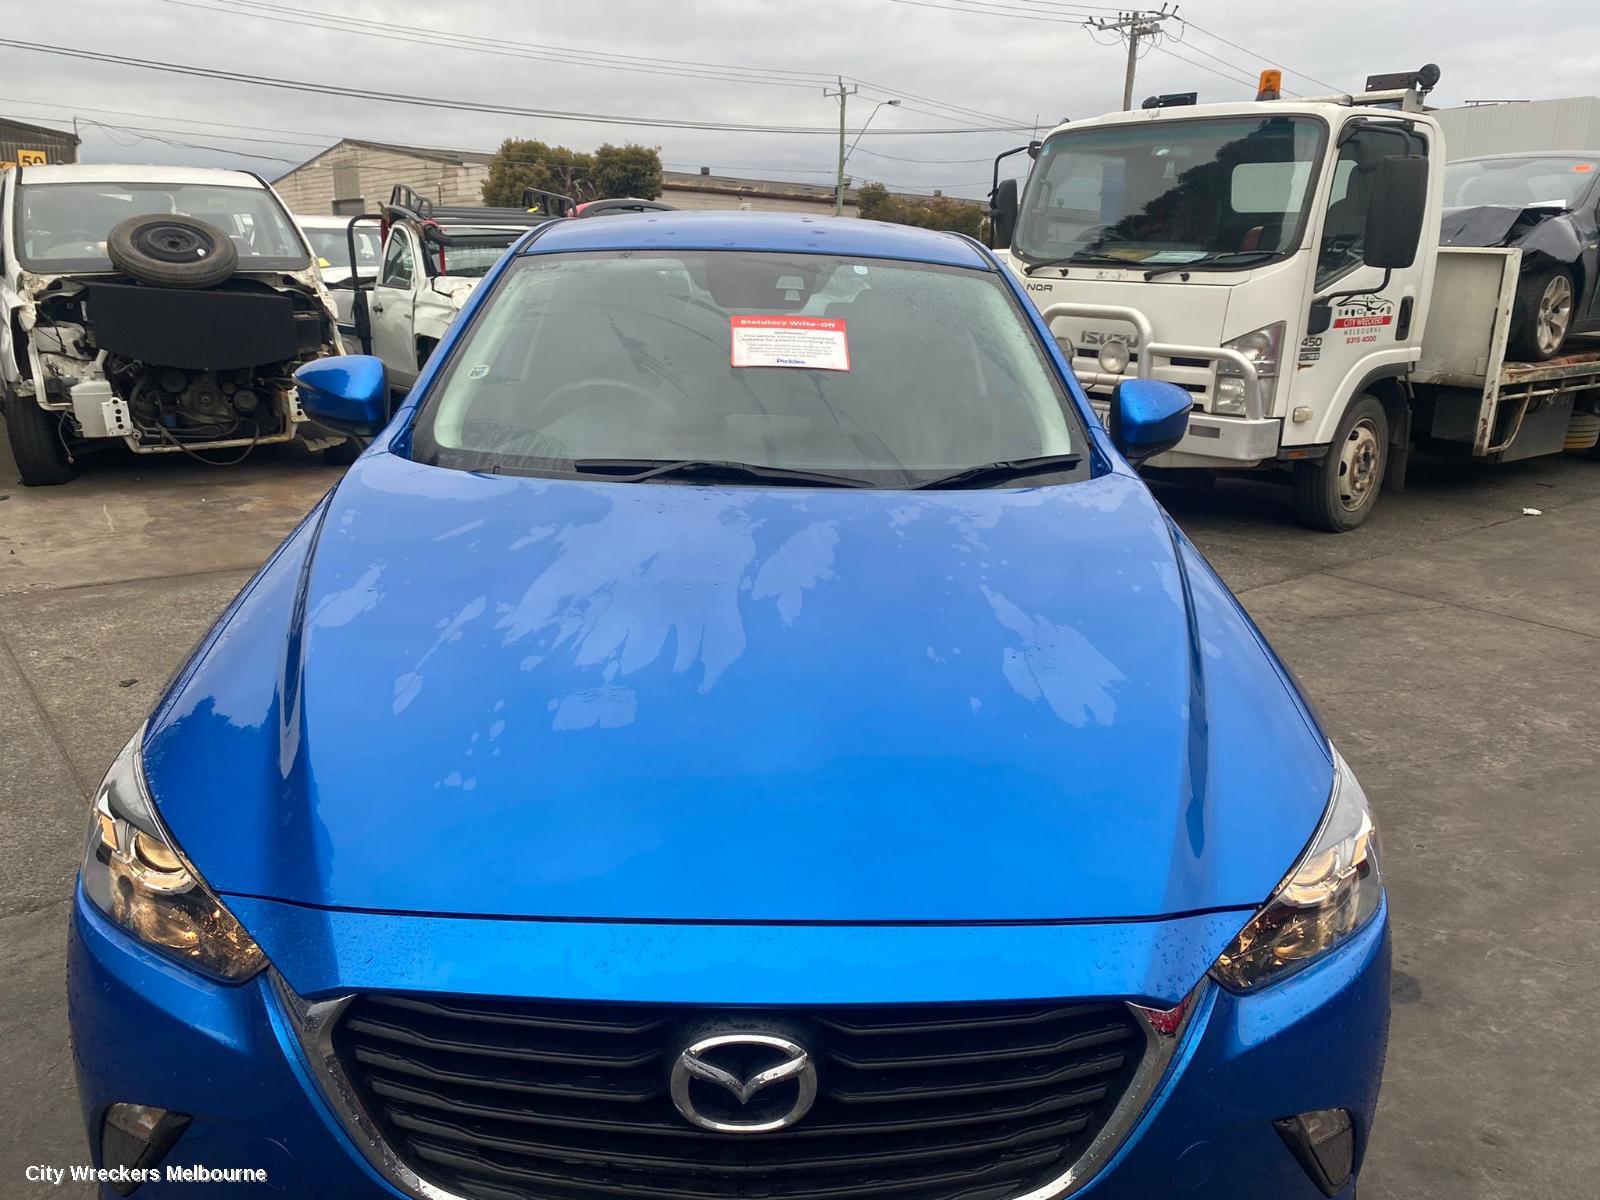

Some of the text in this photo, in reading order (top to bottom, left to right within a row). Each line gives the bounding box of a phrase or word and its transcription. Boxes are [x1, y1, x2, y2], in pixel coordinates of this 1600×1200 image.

[789, 320, 836, 328] Write-Off
[1343, 316, 1384, 327] CITY WRECKERS
[1081, 330, 1139, 348] ISUZU
[1301, 337, 1322, 346] 450
